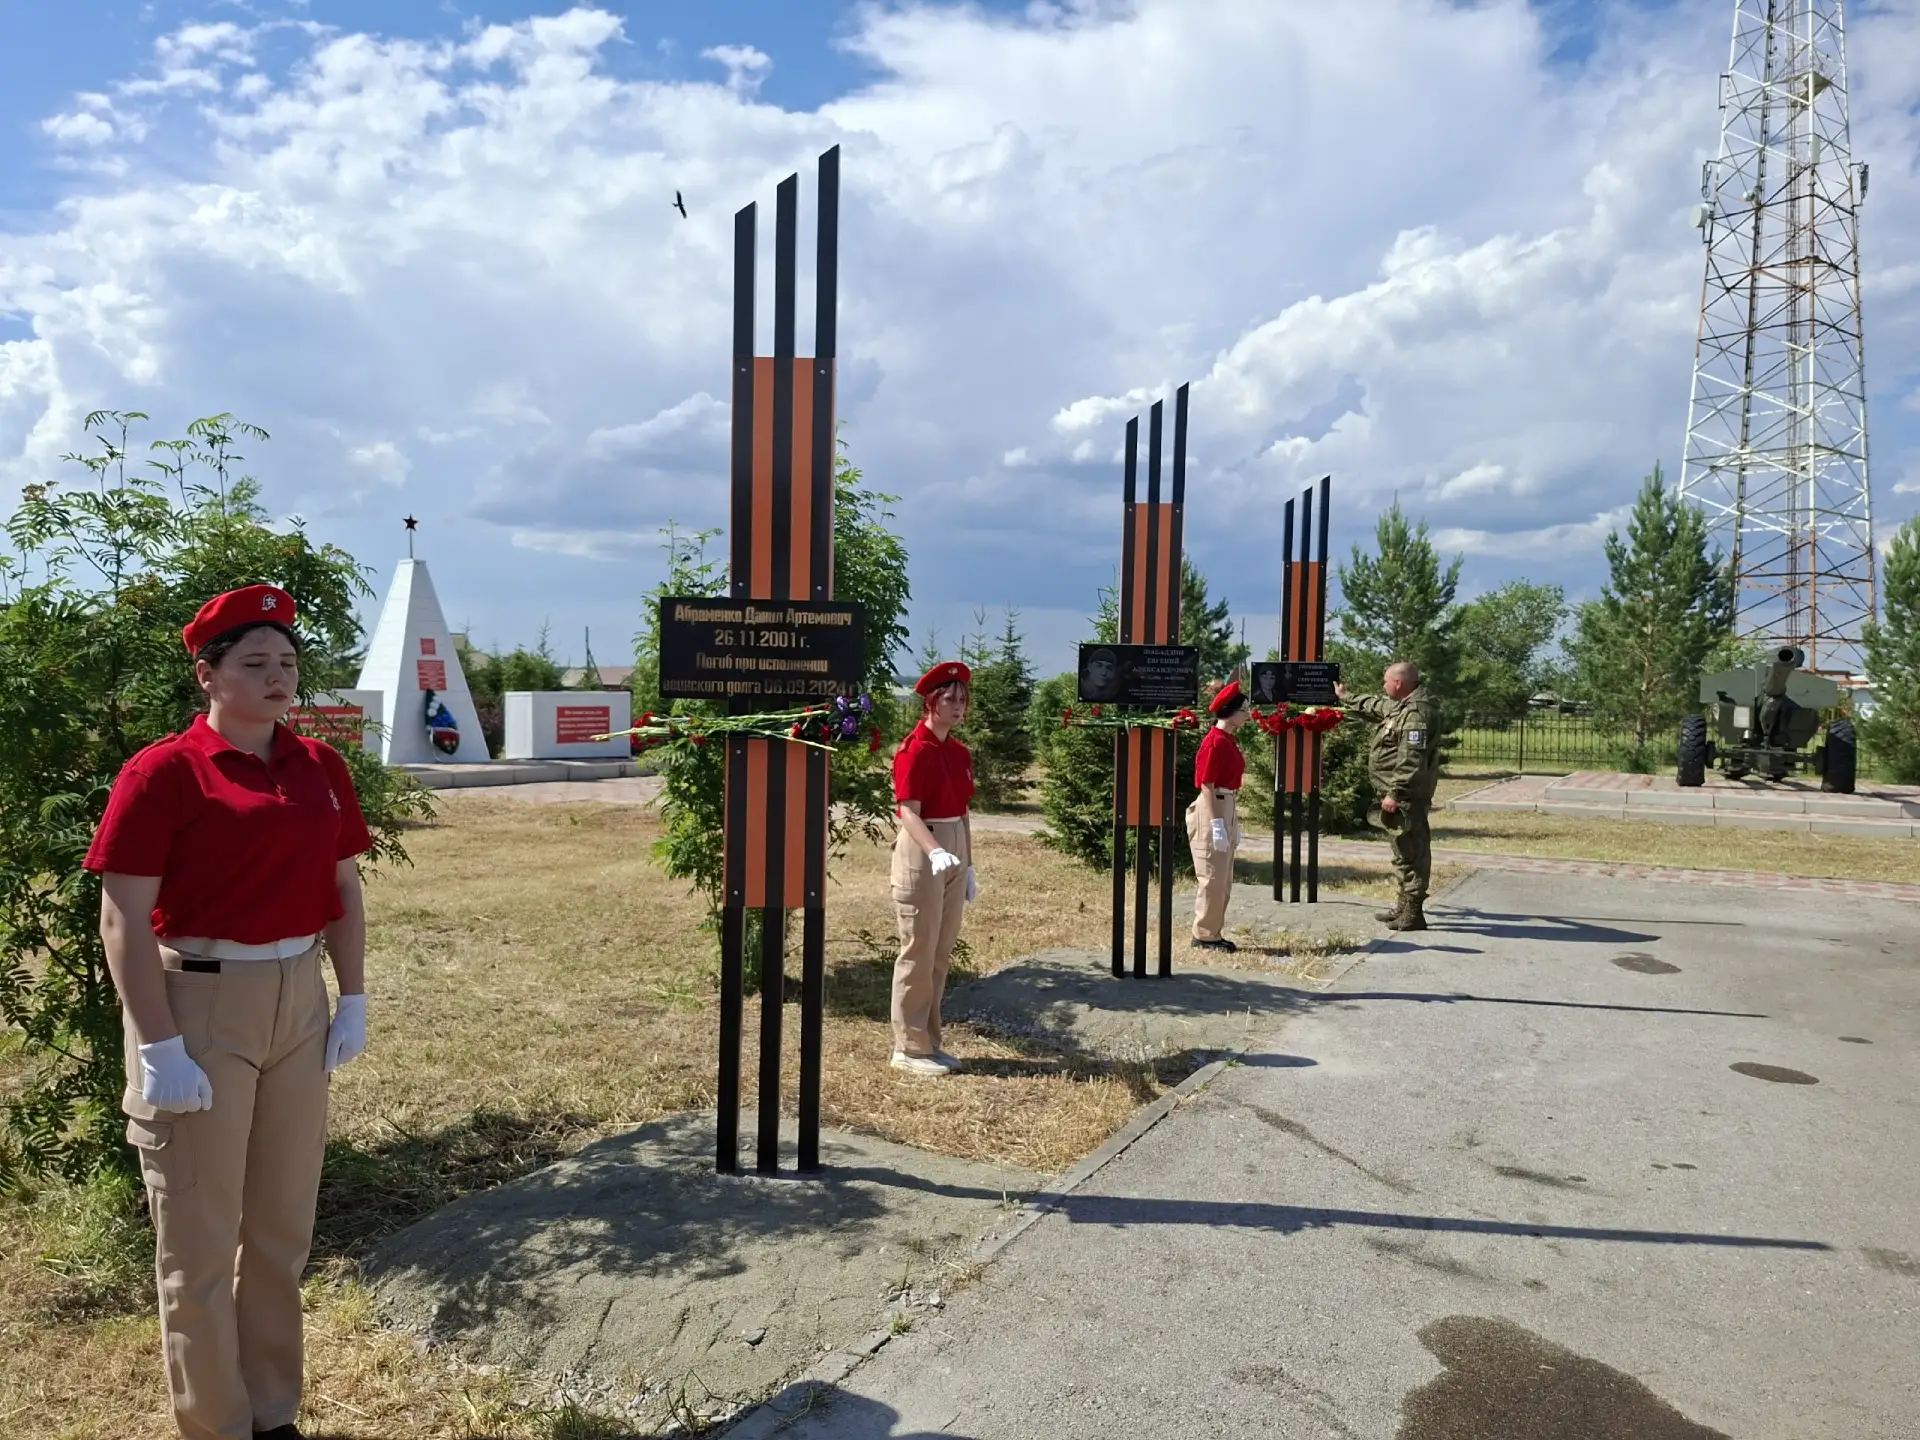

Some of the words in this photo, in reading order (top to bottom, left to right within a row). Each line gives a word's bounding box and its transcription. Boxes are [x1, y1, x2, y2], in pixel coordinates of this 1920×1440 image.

[674, 604, 743, 625] Абраменко
[744, 606, 784, 625] Данил
[786, 608, 853, 627] Артемович
[714, 629, 797, 648] 26.11.2001
[800, 636, 811, 648] г.
[696, 652, 733, 670] Погиб
[735, 657, 756, 673] при
[759, 658, 828, 673] исполнении
[663, 679, 724, 693] воинского
[727, 680, 761, 696] долга
